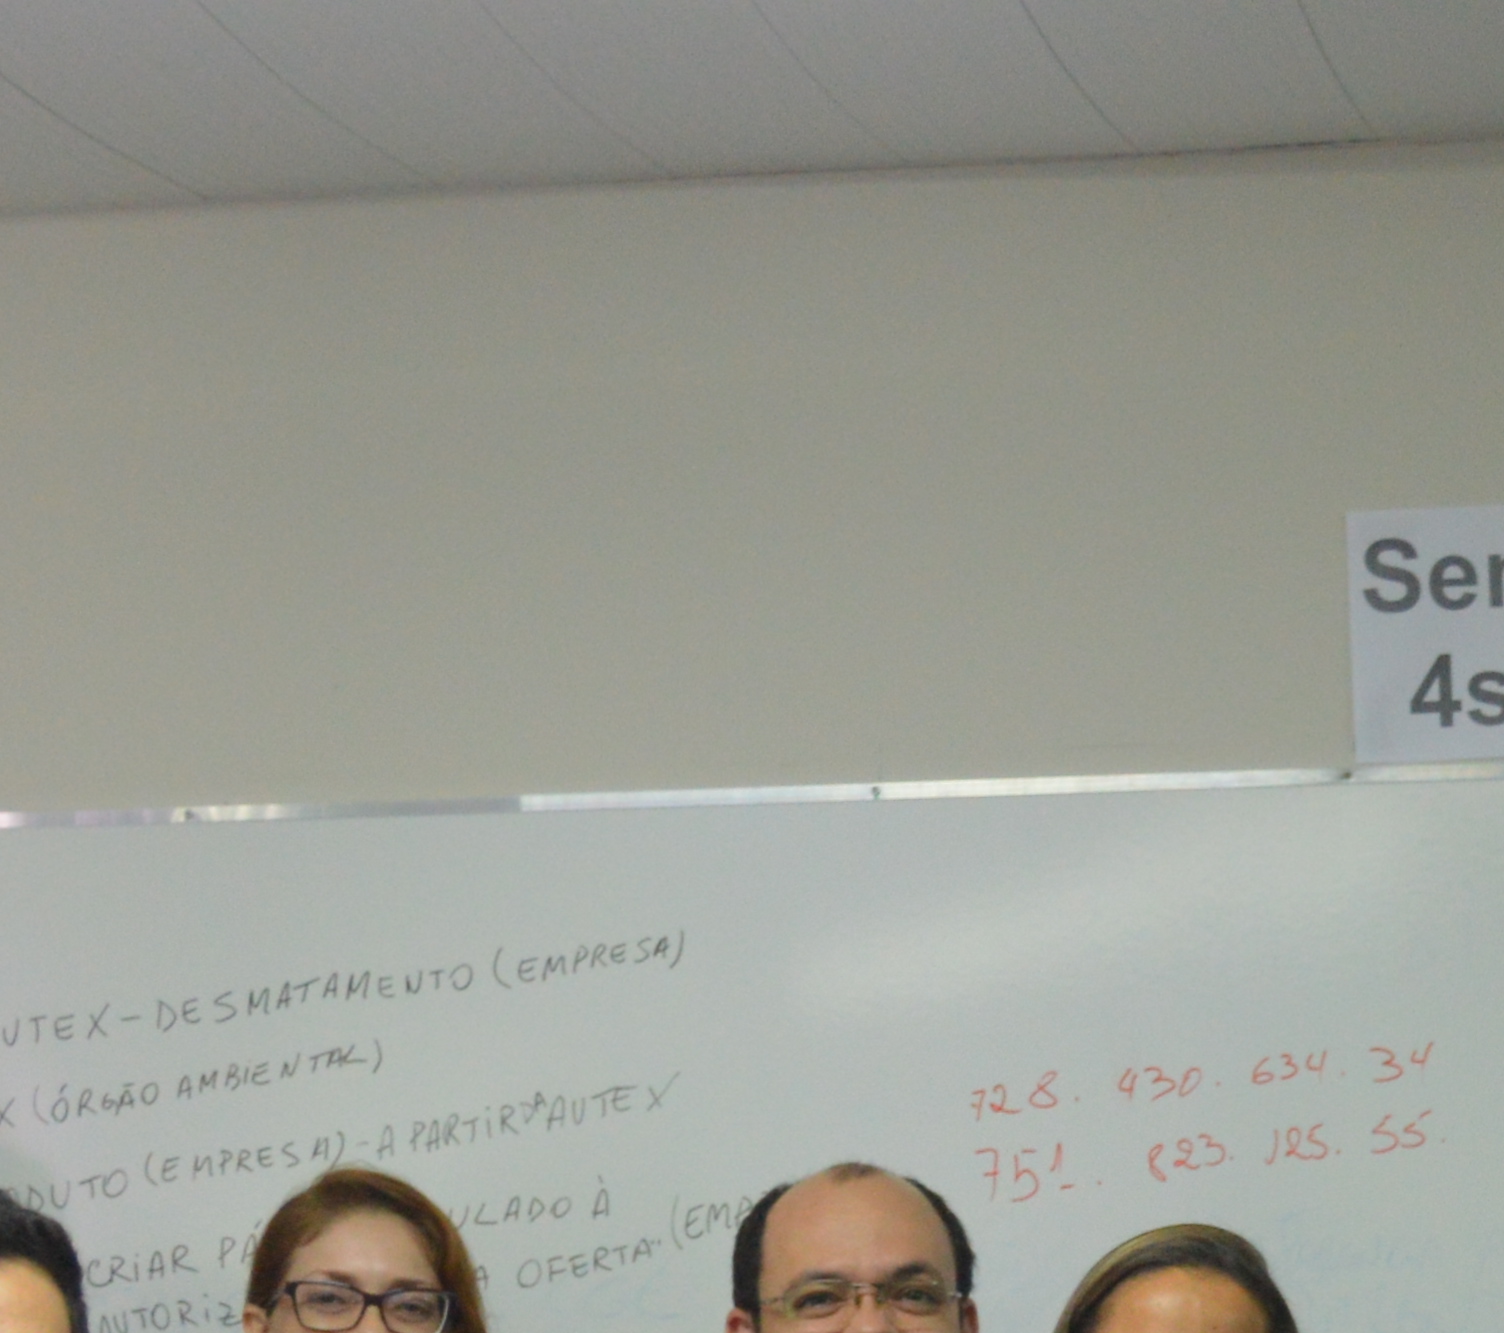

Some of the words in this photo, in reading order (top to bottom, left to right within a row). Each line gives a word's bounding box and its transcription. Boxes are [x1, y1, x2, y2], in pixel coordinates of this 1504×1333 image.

[493, 930, 685, 989] (EMPRESA)
[177, 1041, 383, 1099] AMBIENTAL)
[87, 1245, 200, 1287] CRIAR
